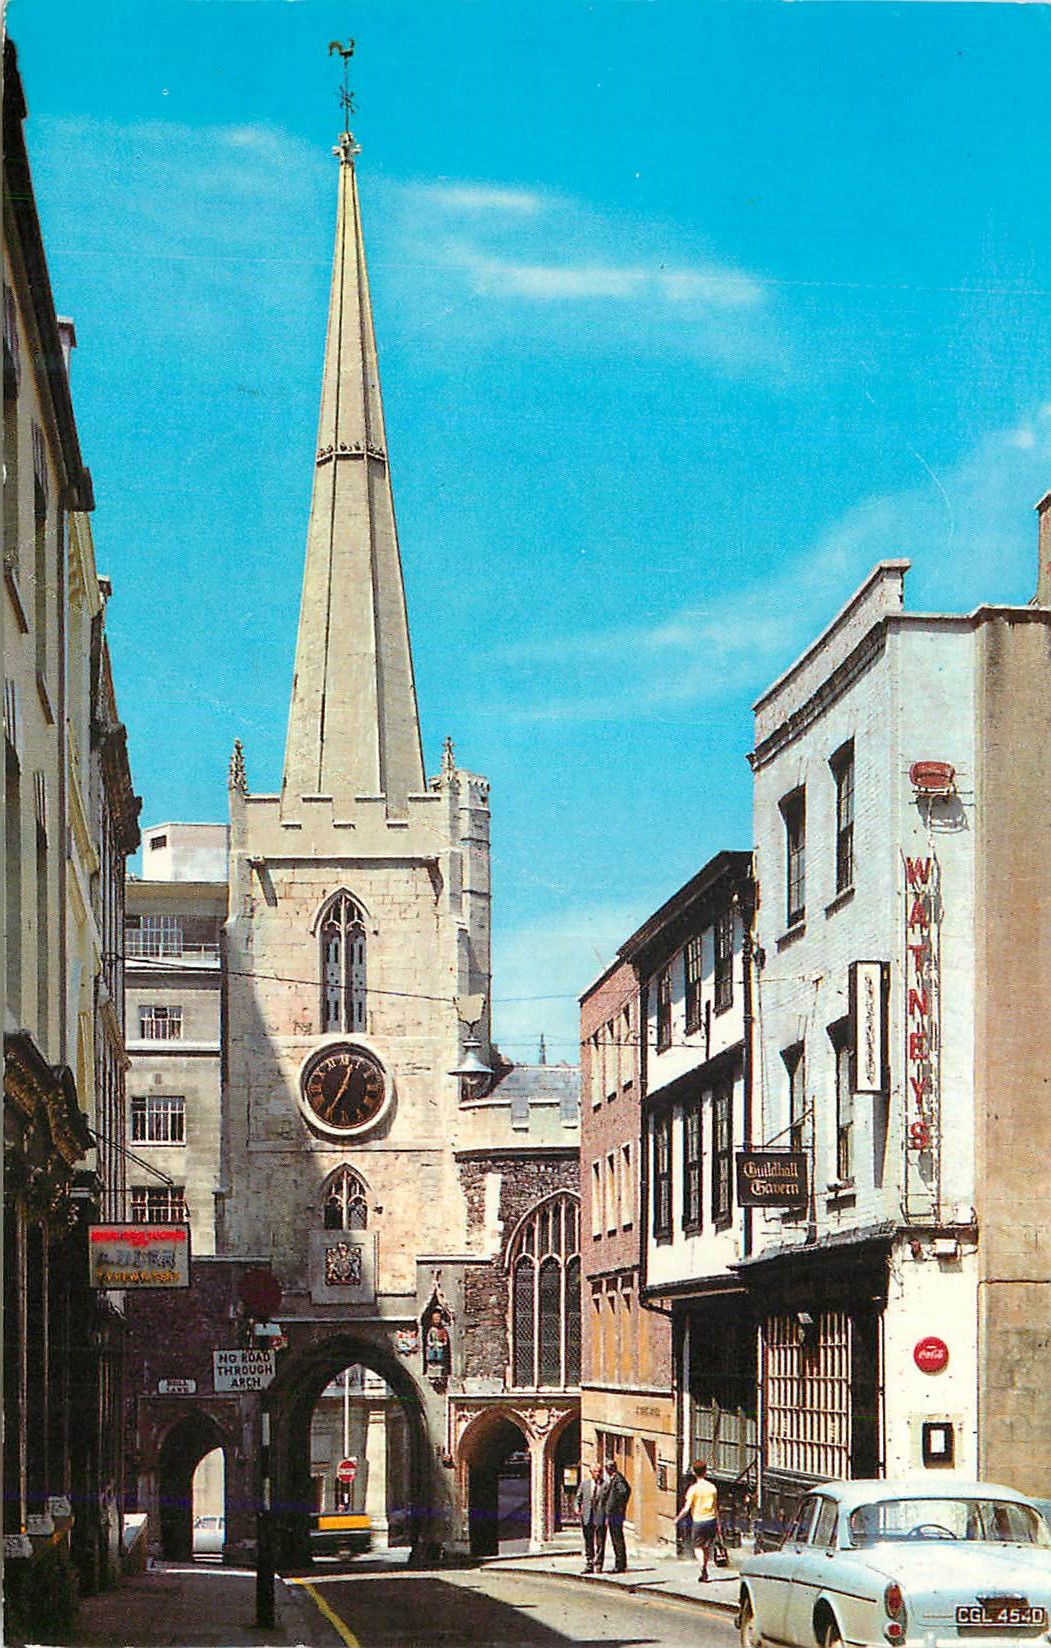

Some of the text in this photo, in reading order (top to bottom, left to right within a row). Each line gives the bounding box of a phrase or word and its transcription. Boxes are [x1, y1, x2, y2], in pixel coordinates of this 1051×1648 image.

[906, 857, 931, 1150] WATNEYS
[743, 1161, 798, 1178] Guildhall
[751, 1179, 799, 1196] Tavern
[218, 1352, 271, 1363] NO ROAD
[217, 1364, 273, 1376] THROUGH
[231, 1377, 261, 1388] ARCH
[958, 1608, 993, 1623] CGL
